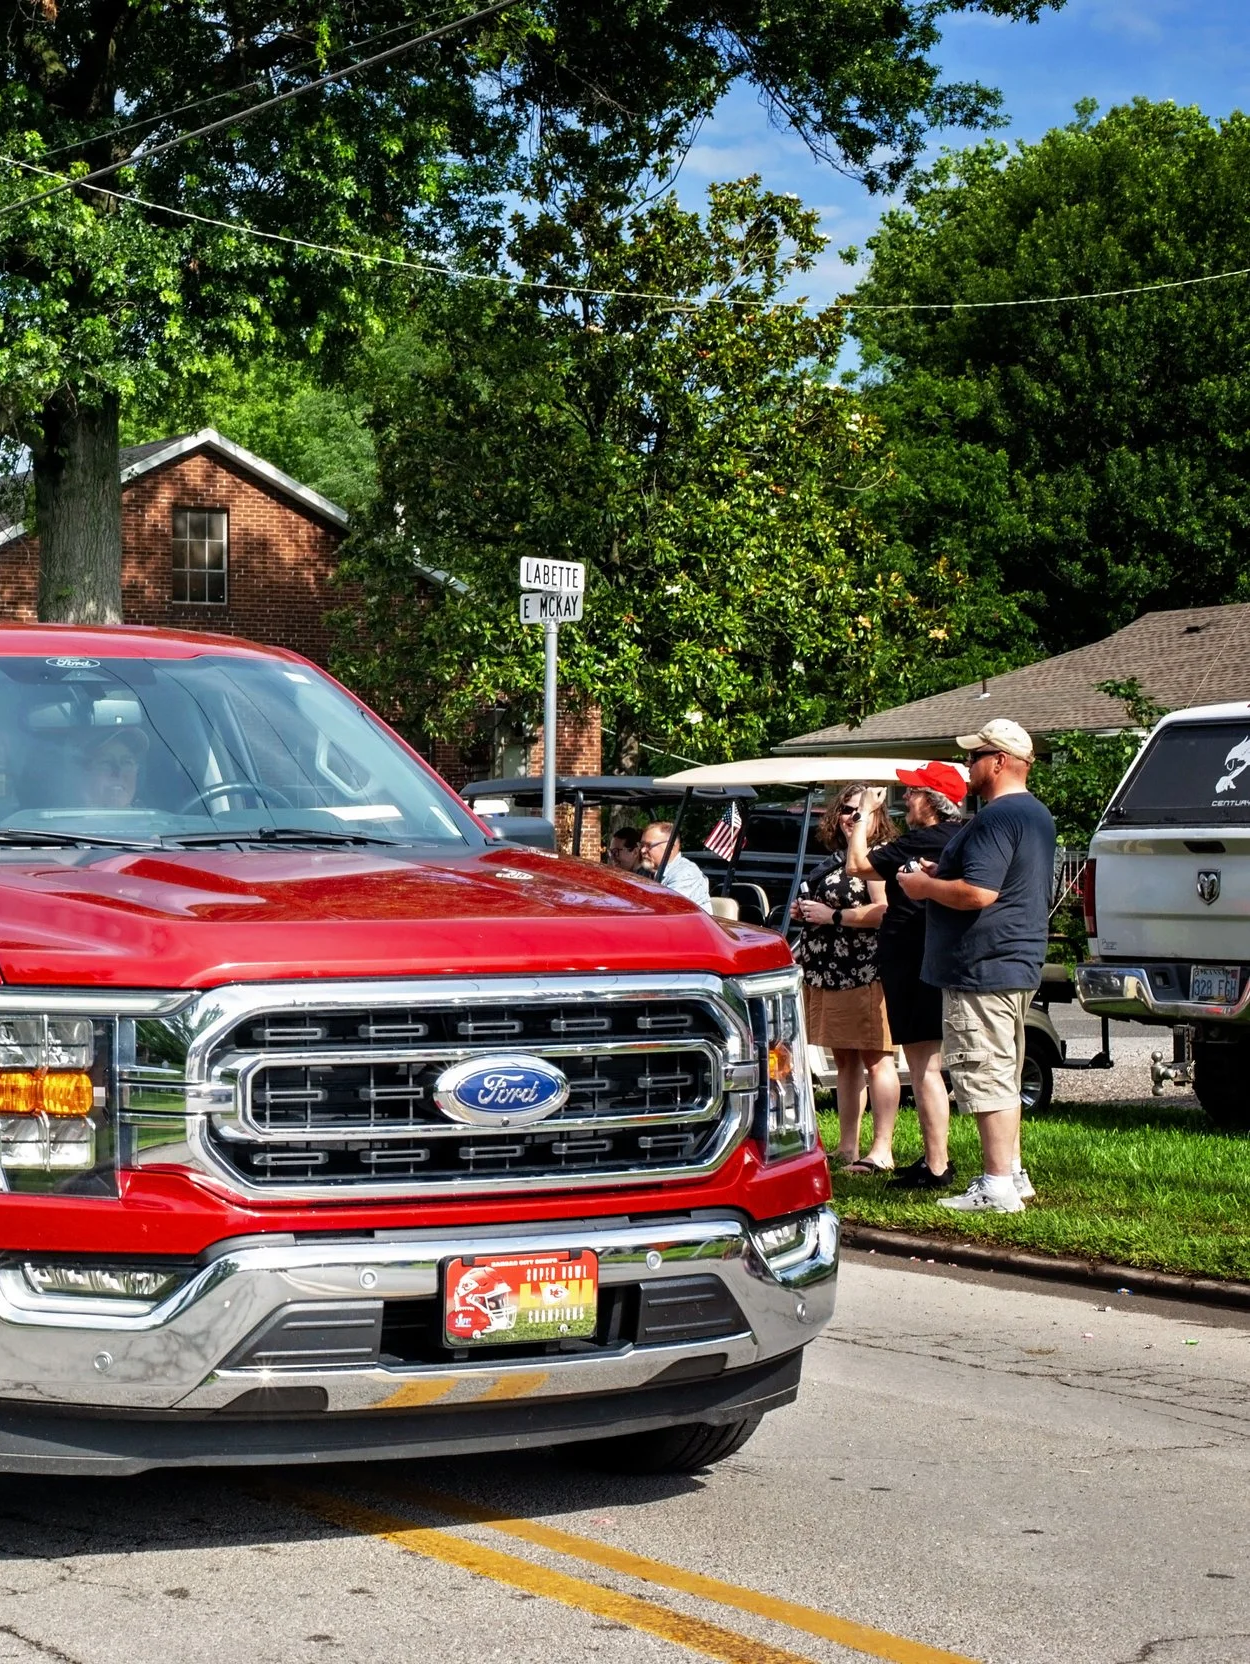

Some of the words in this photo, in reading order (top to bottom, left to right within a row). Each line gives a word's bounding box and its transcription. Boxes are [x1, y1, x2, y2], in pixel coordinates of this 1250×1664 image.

[526, 562, 578, 588] LABETTE
[523, 598, 530, 619] E
[539, 595, 579, 618] MCKAY
[56, 658, 91, 667] Ford
[477, 1074, 540, 1104] Ford
[526, 1266, 556, 1282] SUPER
[561, 1265, 587, 1280] BOWL
[528, 1306, 585, 1324] CHAMPIONS
